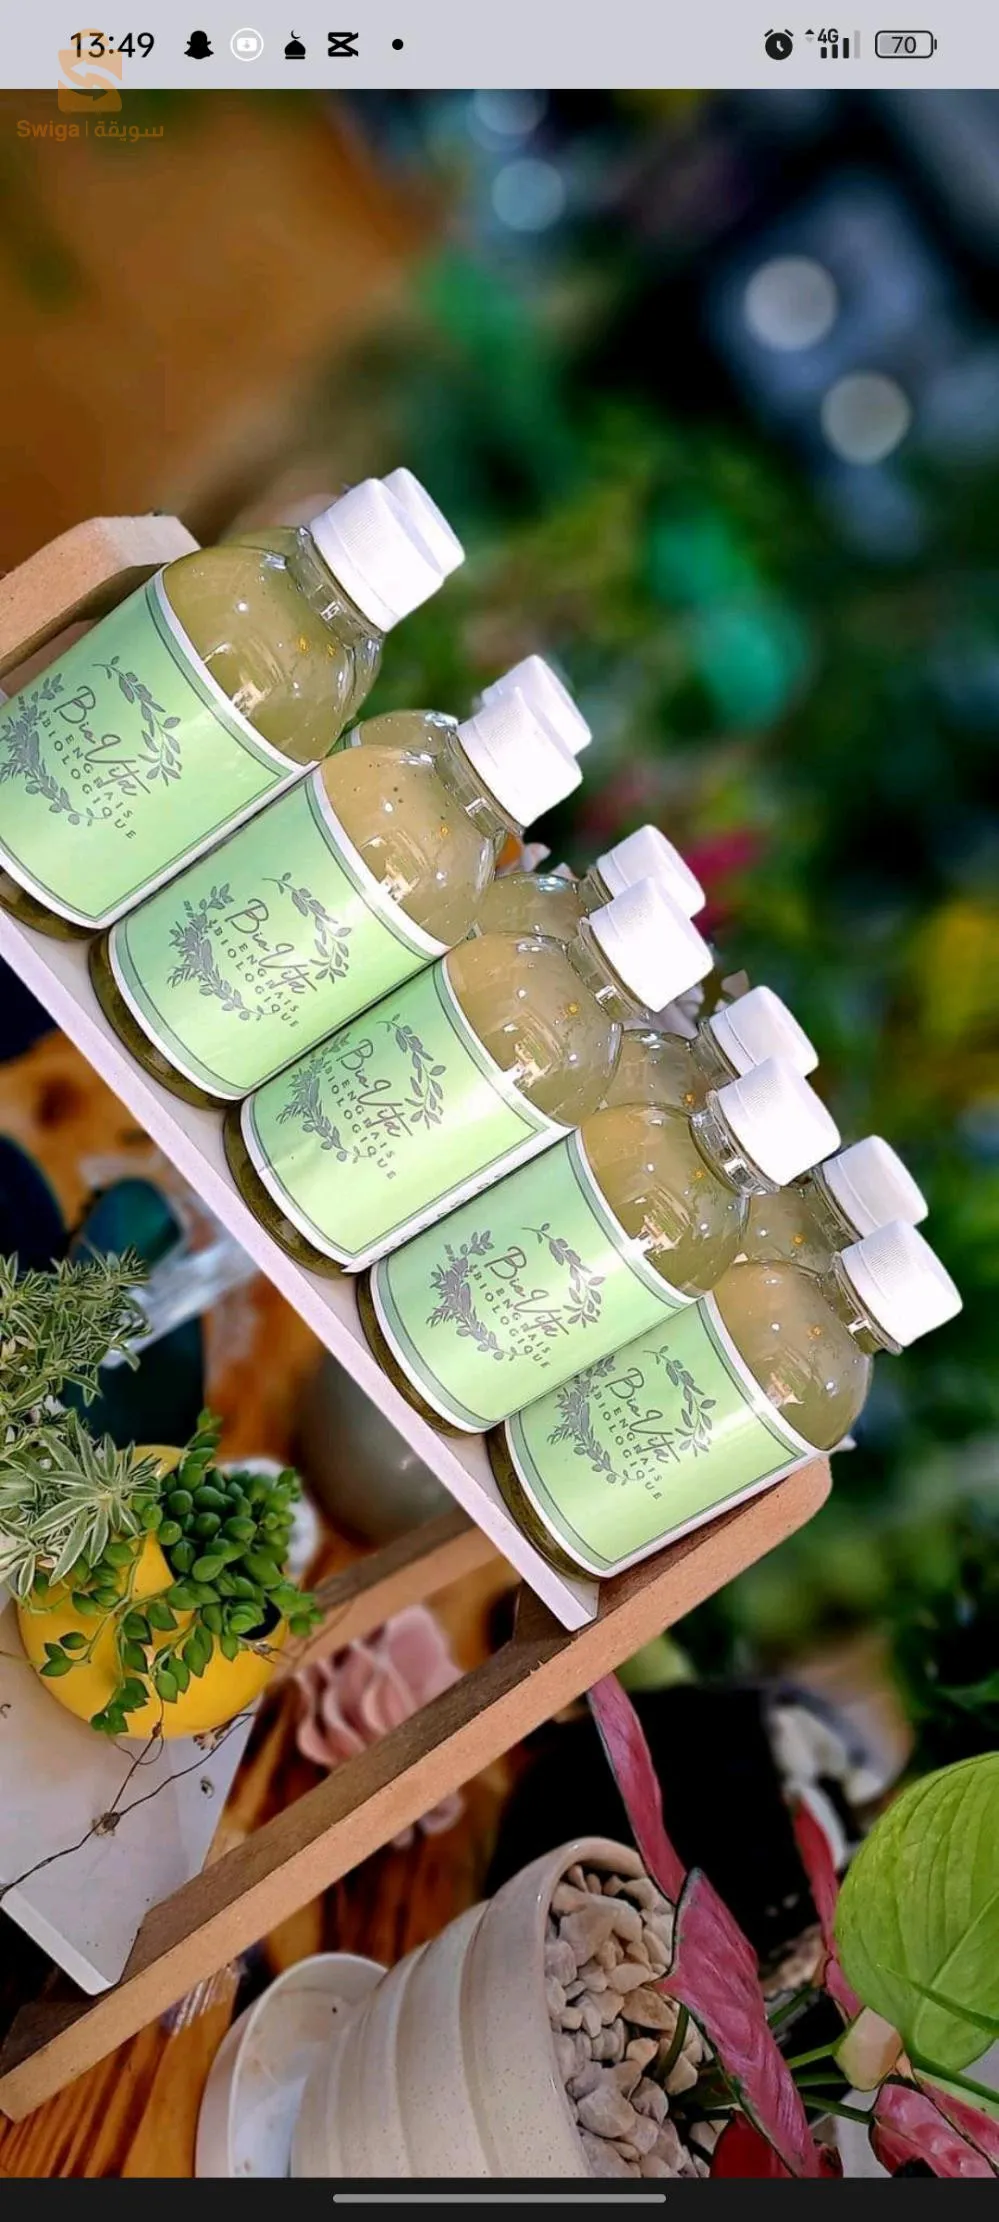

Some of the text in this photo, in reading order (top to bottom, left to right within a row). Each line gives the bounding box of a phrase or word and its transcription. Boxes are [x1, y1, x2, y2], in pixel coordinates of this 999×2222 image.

[70, 32, 155, 59] 13:49
[817, 28, 839, 44] 4G
[891, 36, 917, 54] 70
[41, 717, 137, 840] BIOLOGIQUE
[213, 926, 300, 1029] BIOLOGIQUE
[324, 1065, 397, 1180] BIOLOGIQUE
[473, 1271, 552, 1369] BIOLOGIQUE
[593, 1390, 663, 1501] BIOLOGIQUE
